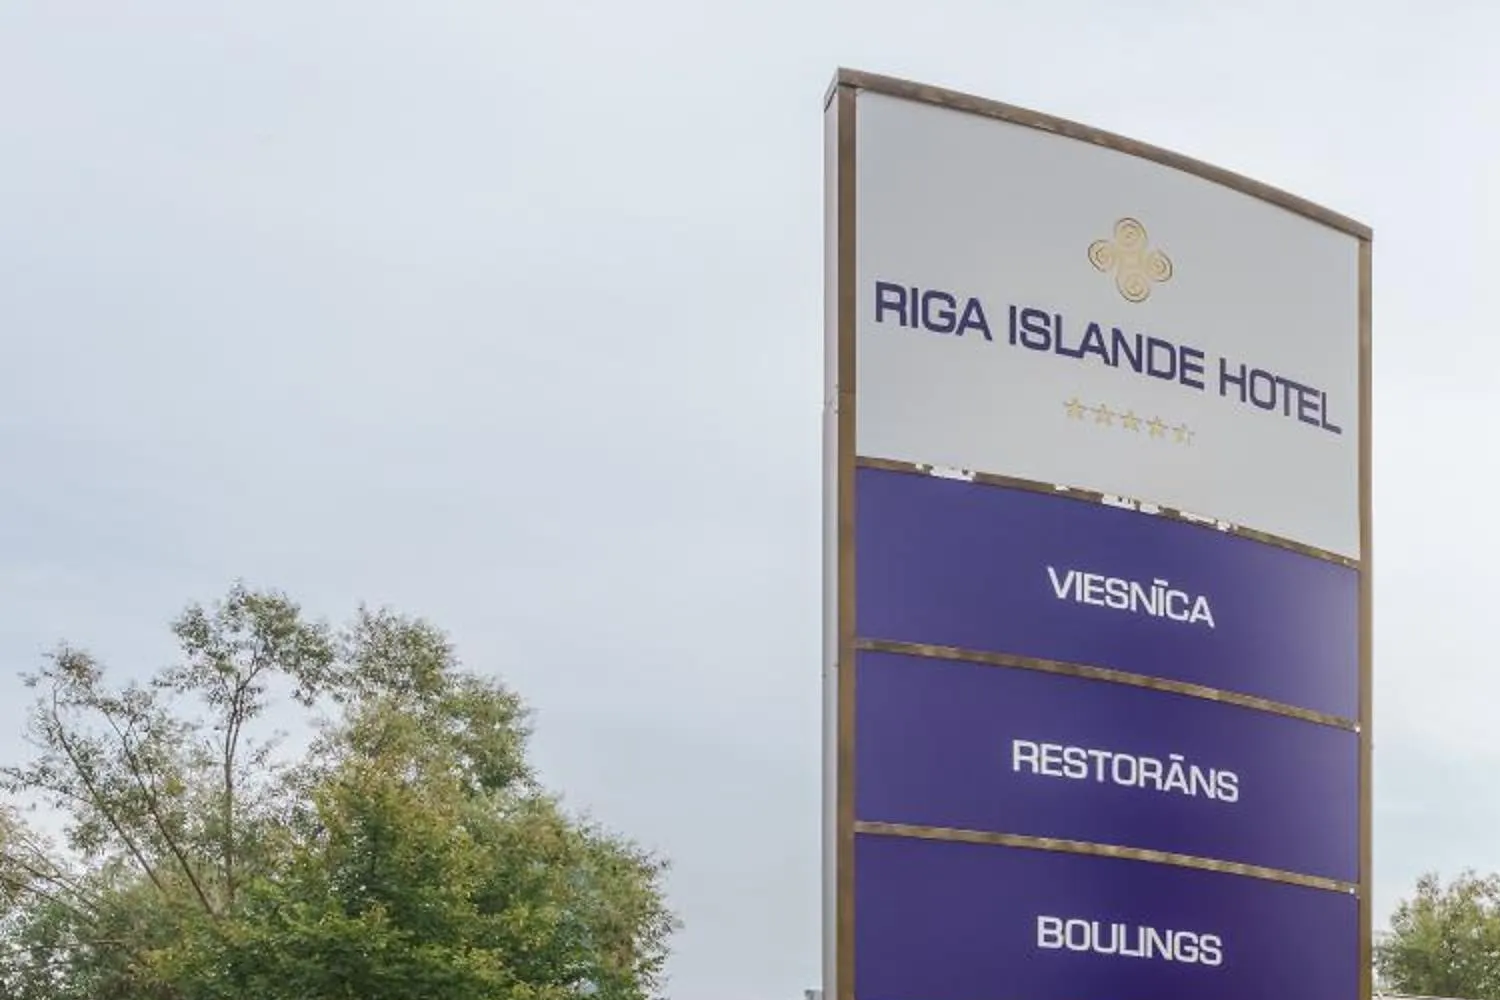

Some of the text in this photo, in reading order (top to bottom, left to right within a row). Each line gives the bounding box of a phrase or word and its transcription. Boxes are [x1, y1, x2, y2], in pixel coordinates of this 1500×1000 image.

[875, 281, 1343, 435] RIGA ISLANDE HOTEL
[1046, 566, 1215, 628] VIESNĪCA
[1012, 739, 1239, 803] RESTORĀNS
[1036, 915, 1223, 966] BOULINGS
